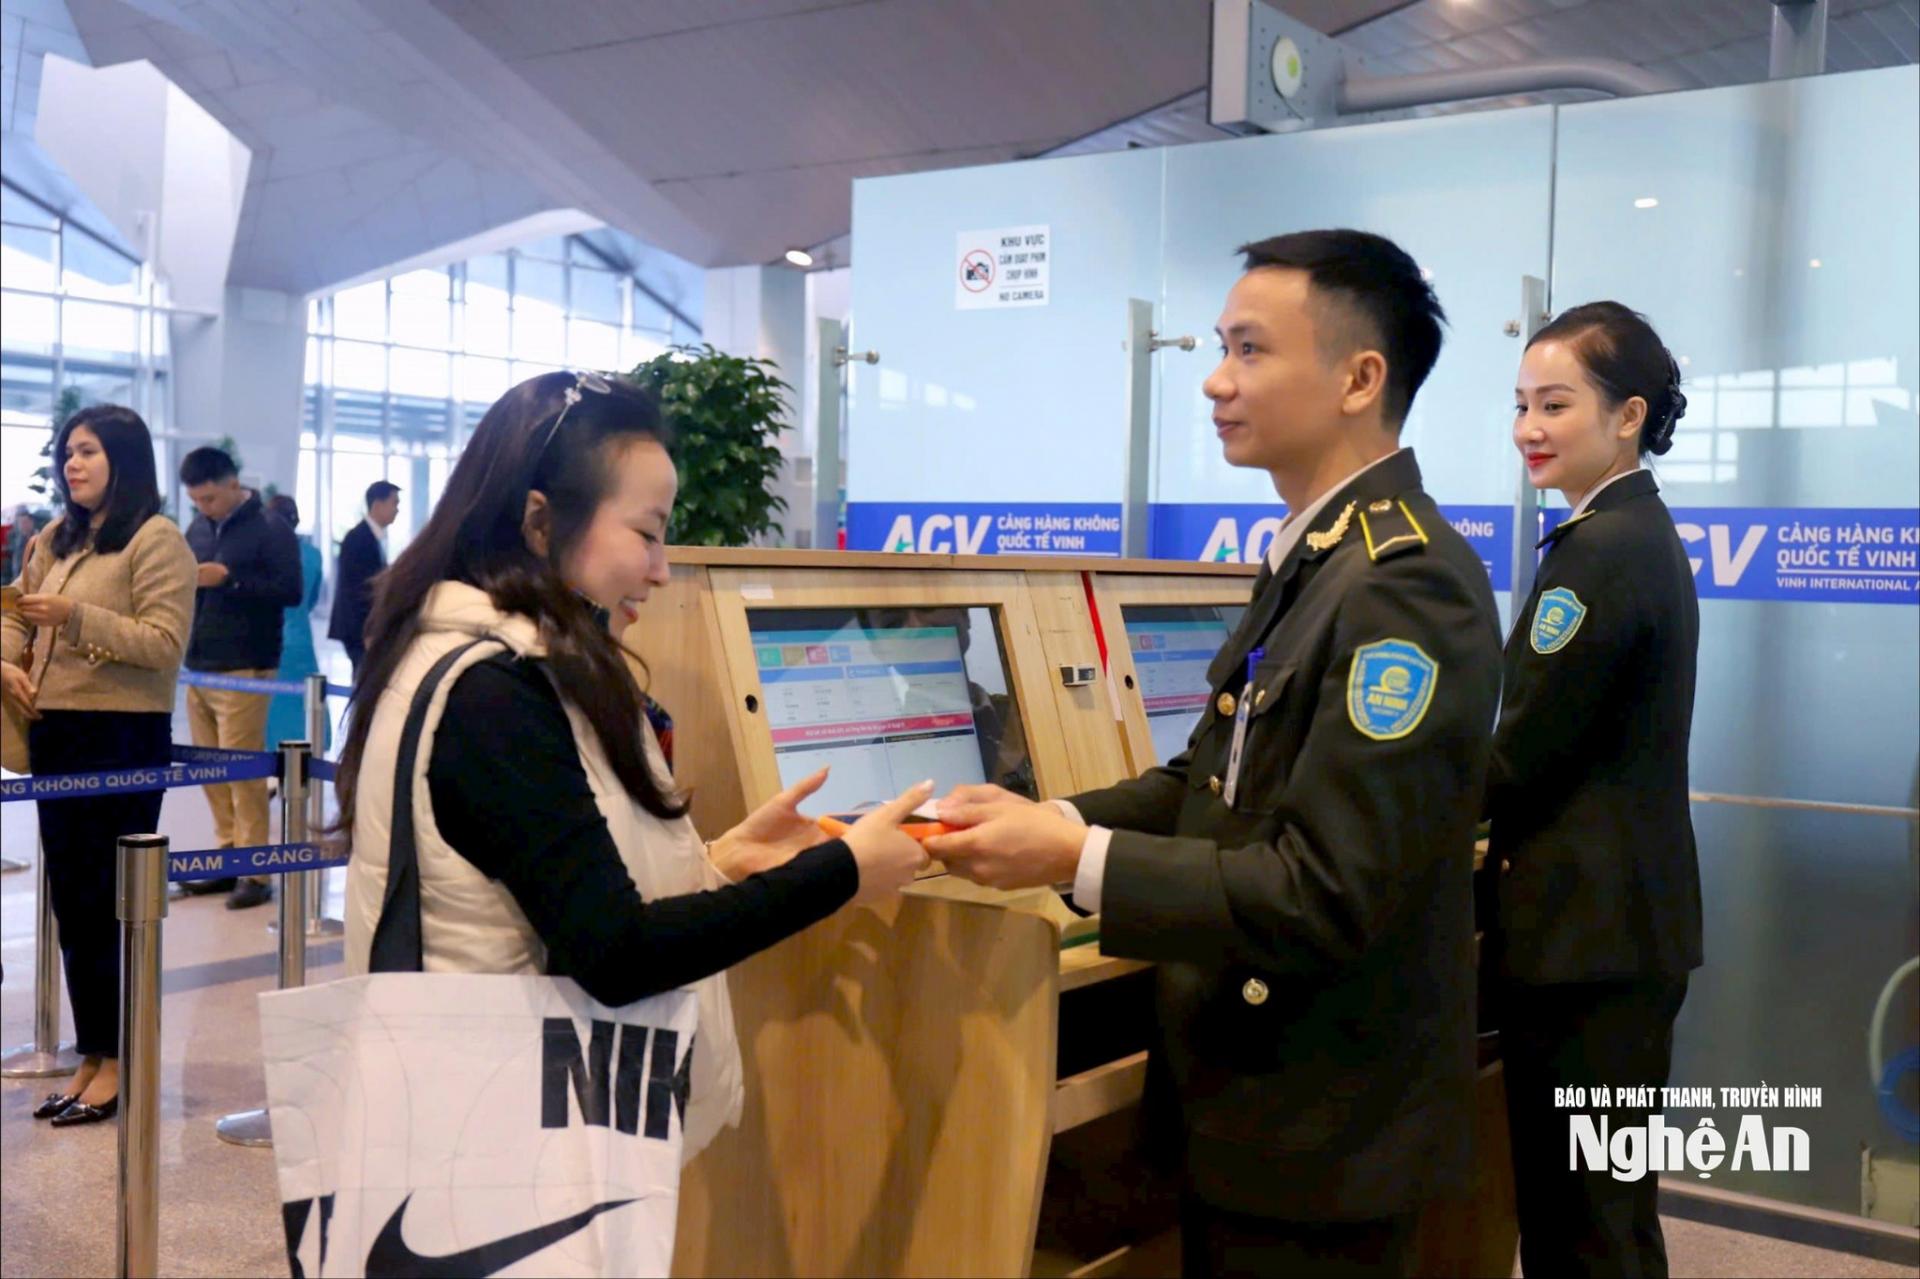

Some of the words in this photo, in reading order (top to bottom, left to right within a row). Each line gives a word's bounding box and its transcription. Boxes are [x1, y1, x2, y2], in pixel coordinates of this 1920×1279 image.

[882, 514, 993, 555] ACV
[997, 513, 1032, 531] CẢNG
[1034, 513, 1071, 532] HÀNG
[1073, 514, 1120, 532] KHÔNG
[1777, 521, 1832, 543] CẢNG
[1836, 522, 1894, 545] HÀNG
[997, 531, 1031, 551] QUỐC
[1033, 531, 1050, 550] TẾ
[1052, 536, 1085, 550] VINH
[1776, 543, 1830, 569] QUỐC
[1835, 543, 1861, 567] TẾ
[1866, 551, 1916, 568] VINH
[1776, 577, 1807, 589] VINH
[1810, 577, 1911, 592] INTERNATIONAL
[32, 774, 101, 793] KHÔNG
[105, 768, 158, 788] QUỐC
[162, 765, 184, 782] TẾ
[188, 766, 228, 780] VINH
[169, 855, 223, 874] NAM
[251, 846, 313, 867] CẢNG
